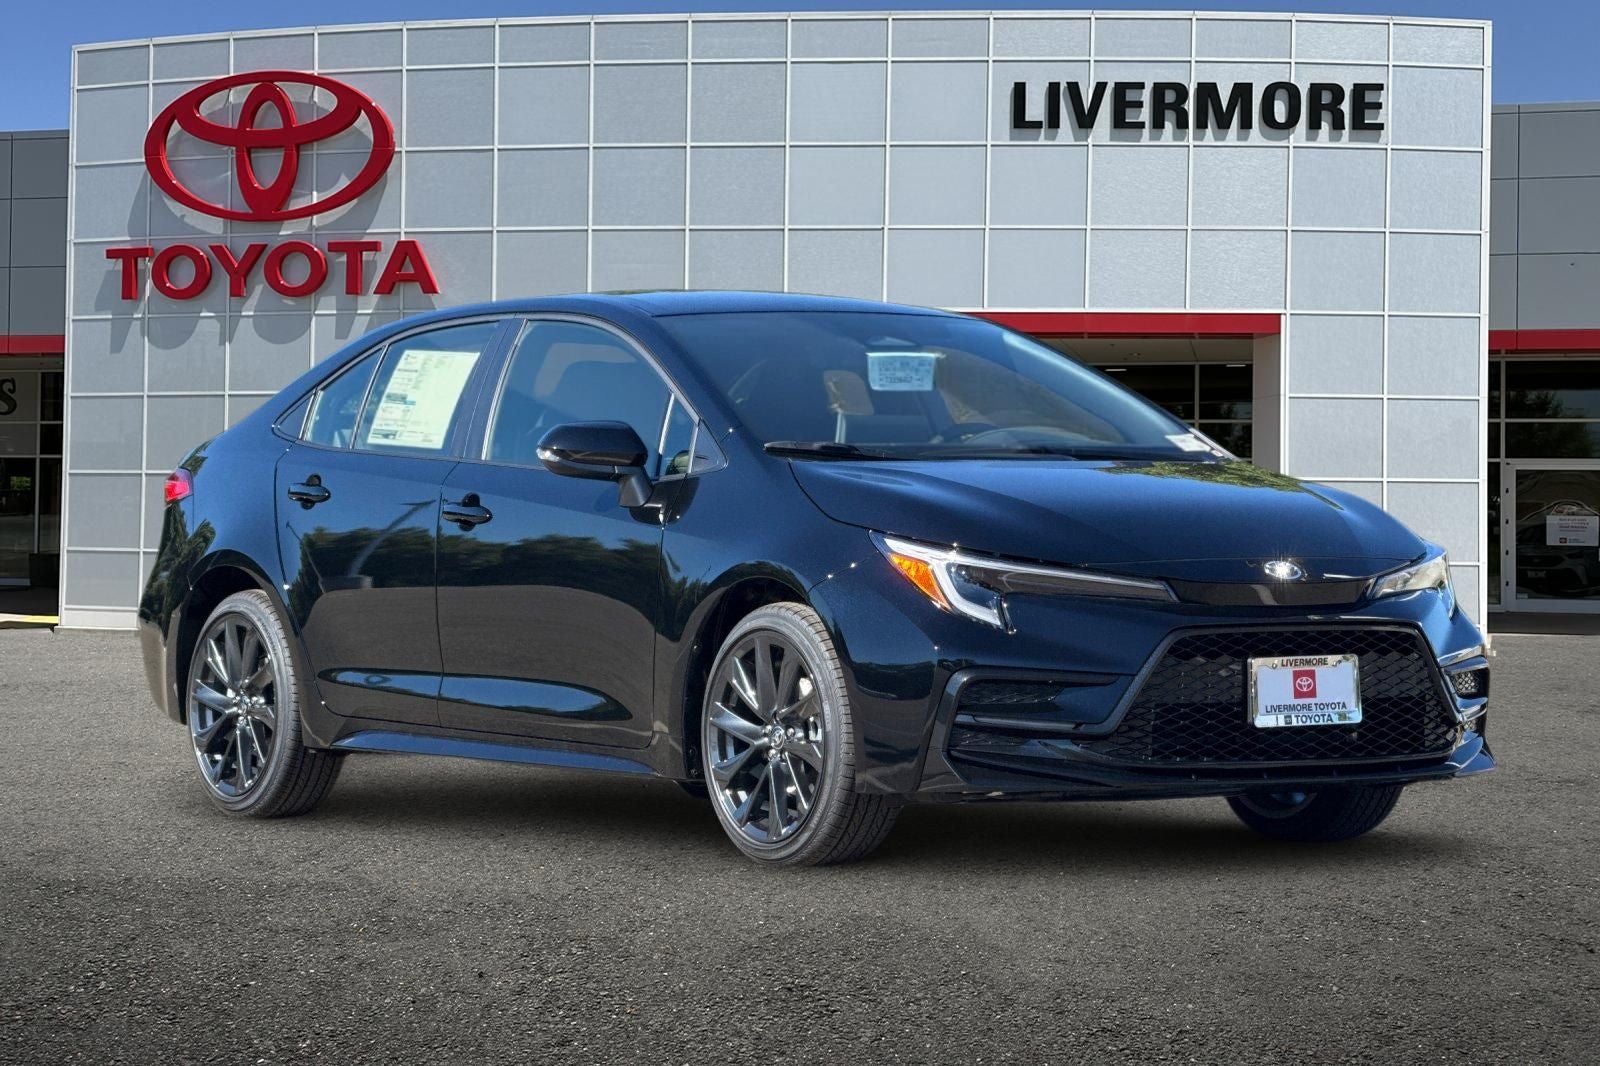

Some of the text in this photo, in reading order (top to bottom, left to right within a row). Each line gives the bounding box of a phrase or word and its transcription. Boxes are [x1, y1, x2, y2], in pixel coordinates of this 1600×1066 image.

[1013, 81, 1385, 130] LIVERMORE
[105, 240, 440, 300] TOYOTA
[1281, 657, 1329, 667] LIVERMORE
[1265, 701, 1347, 714] LIVERMORE TOYOTA
[1294, 713, 1334, 724] TOYOTA
